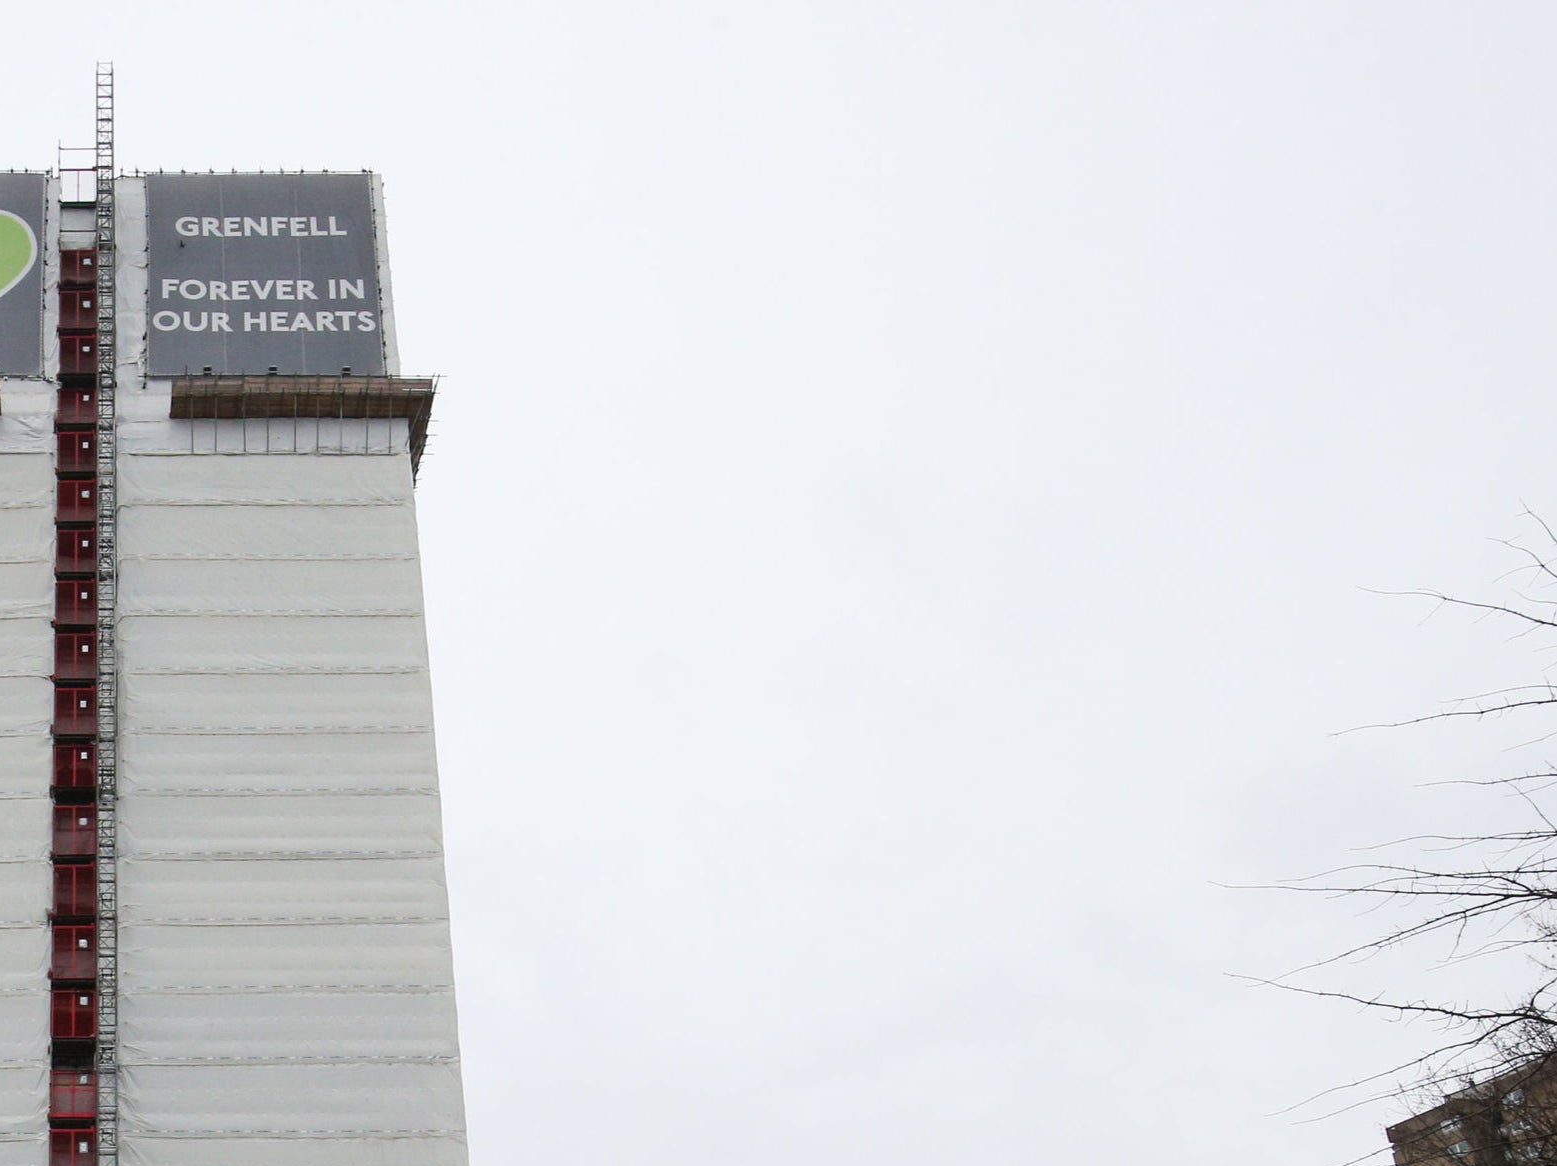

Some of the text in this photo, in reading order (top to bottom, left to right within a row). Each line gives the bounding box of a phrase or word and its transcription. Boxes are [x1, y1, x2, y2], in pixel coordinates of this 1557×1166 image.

[175, 216, 347, 237] GRENFELL
[161, 278, 365, 300] FOREVER IN
[152, 310, 377, 332] OUR HEARTS
